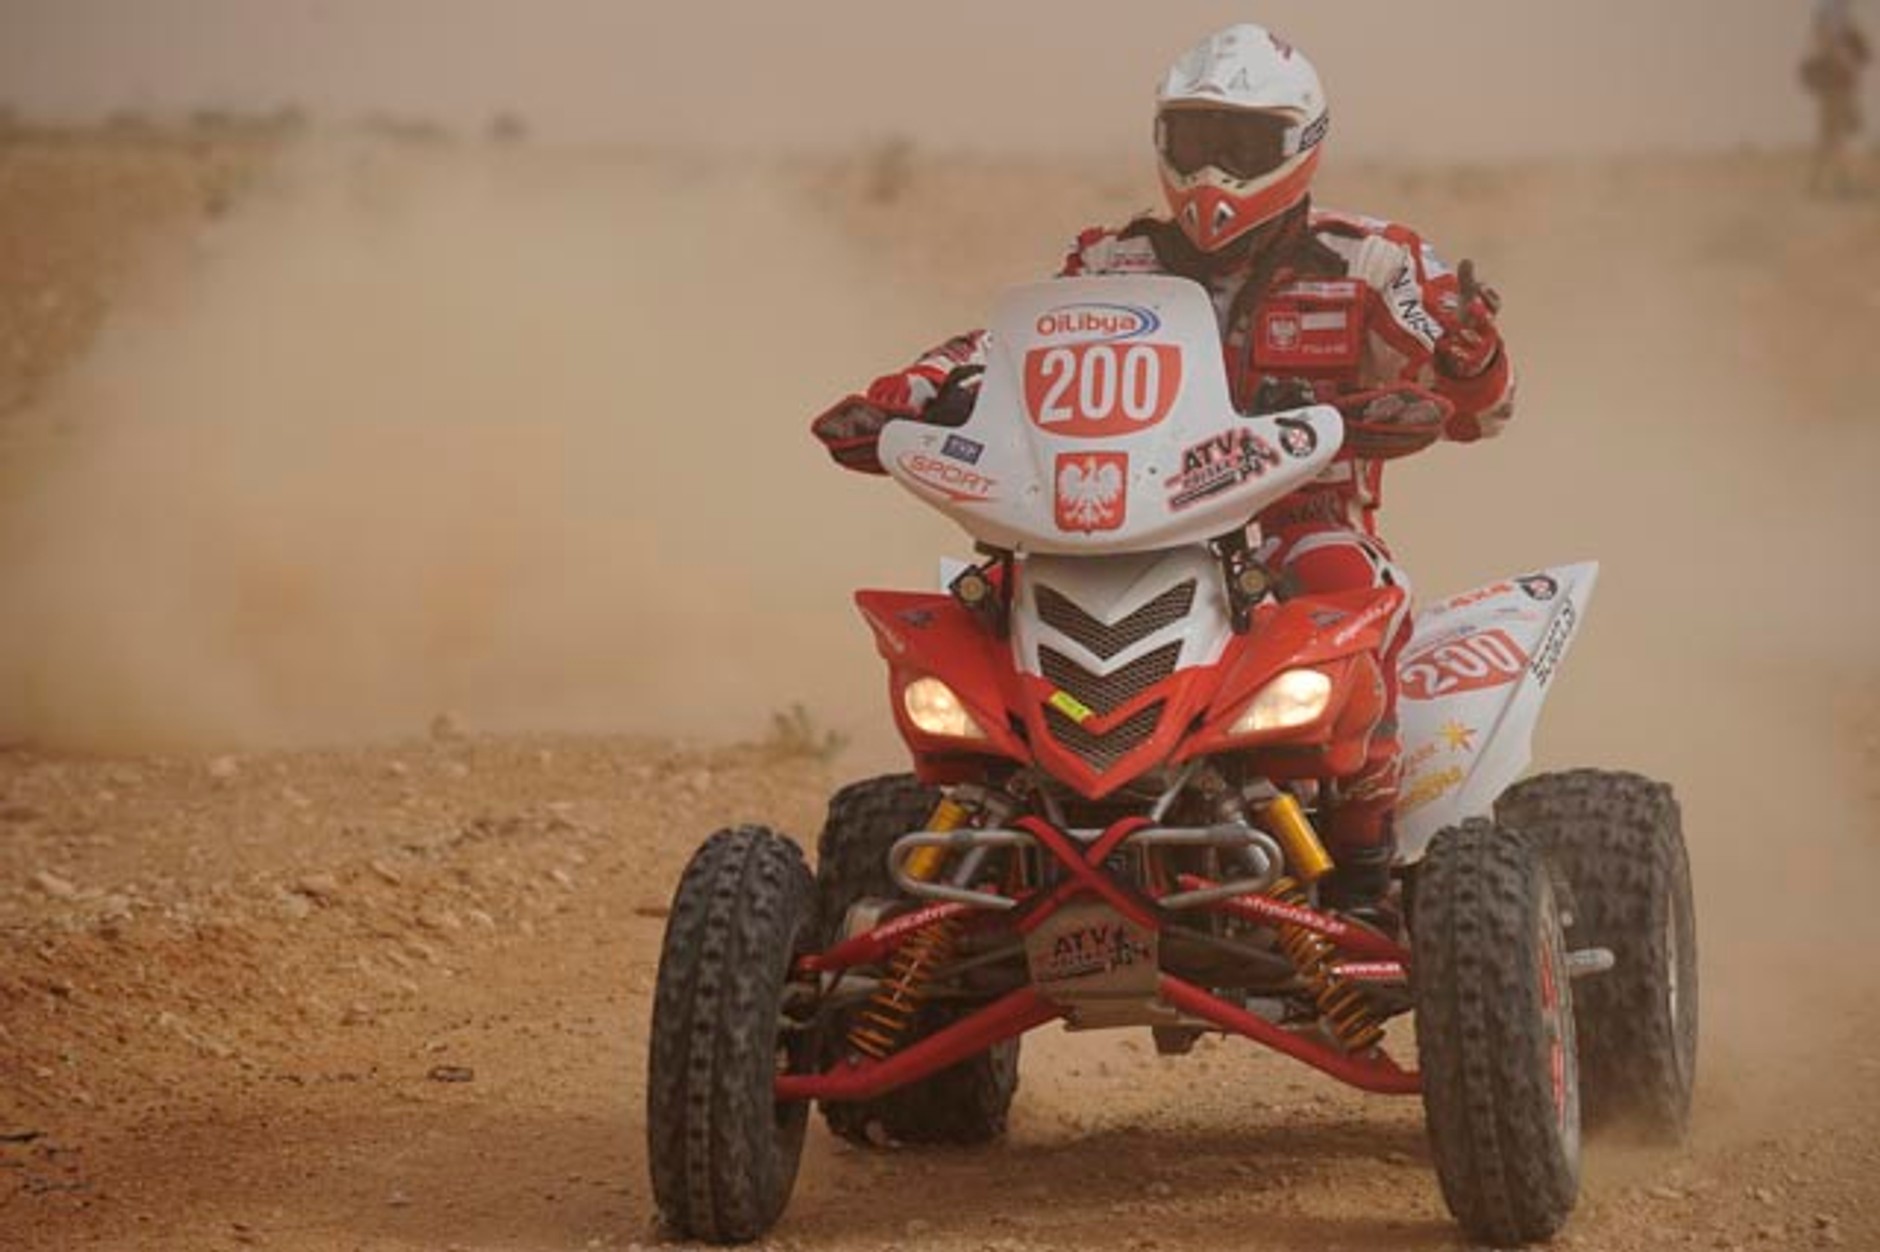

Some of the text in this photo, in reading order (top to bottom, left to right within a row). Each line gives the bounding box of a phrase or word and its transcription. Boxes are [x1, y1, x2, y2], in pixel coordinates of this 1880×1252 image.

[1036, 313, 1137, 336] OiLibya
[1039, 345, 1161, 424] 200
[1183, 429, 1234, 474] ATV
[911, 455, 998, 494] SPORT
[1400, 634, 1521, 695] 200
